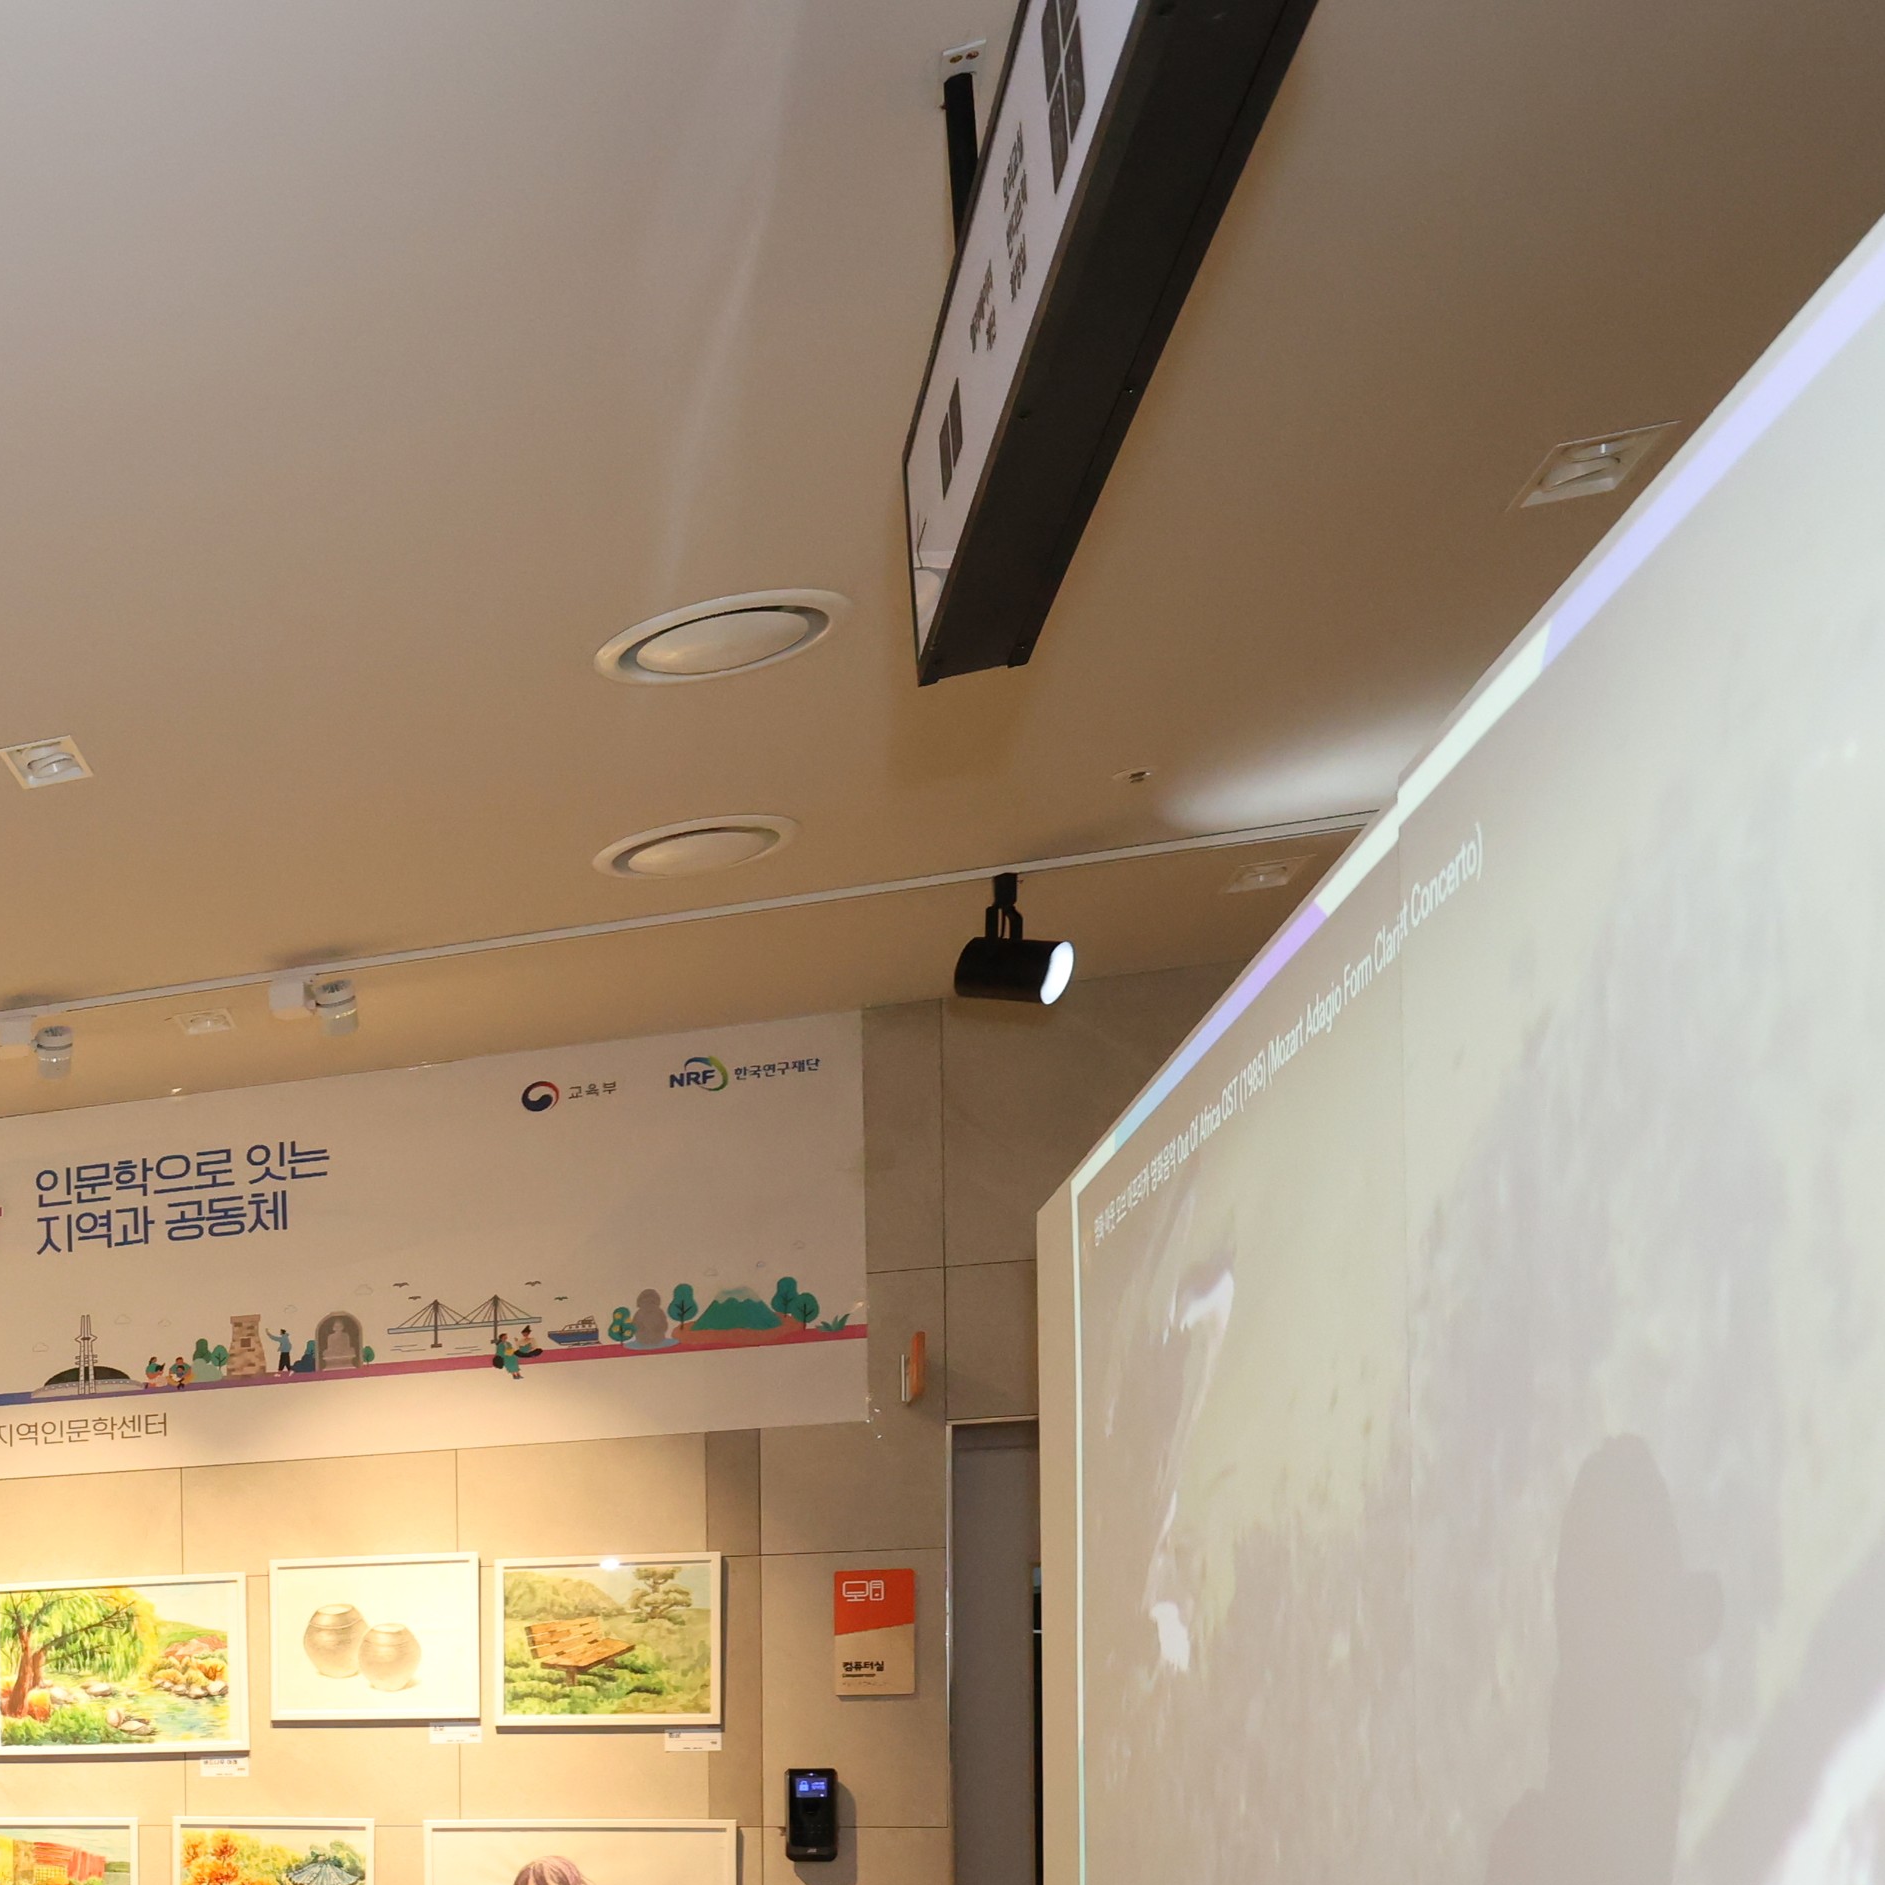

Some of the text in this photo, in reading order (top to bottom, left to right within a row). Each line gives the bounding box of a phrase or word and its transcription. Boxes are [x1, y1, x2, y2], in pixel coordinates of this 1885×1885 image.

[1200, 1104, 1221, 1143] Africa
[1221, 1075, 1238, 1120] OST
[1239, 1049, 1267, 1112] (1985)
[1268, 1015, 1303, 1086] (Mozart
[1305, 981, 1342, 1043] Adagio
[1344, 955, 1372, 1006] Form
[1411, 821, 1483, 928] Concerto)
[669, 1068, 716, 1091] NRF
[734, 1057, 821, 1081] 한국연구재단
[568, 1080, 618, 1100] 교육부
[35, 1140, 330, 1207] 인문학으로 잇는
[36, 1191, 289, 1256] 지역과 공동체
[842, 1660, 885, 1673] 컴퓨터실
